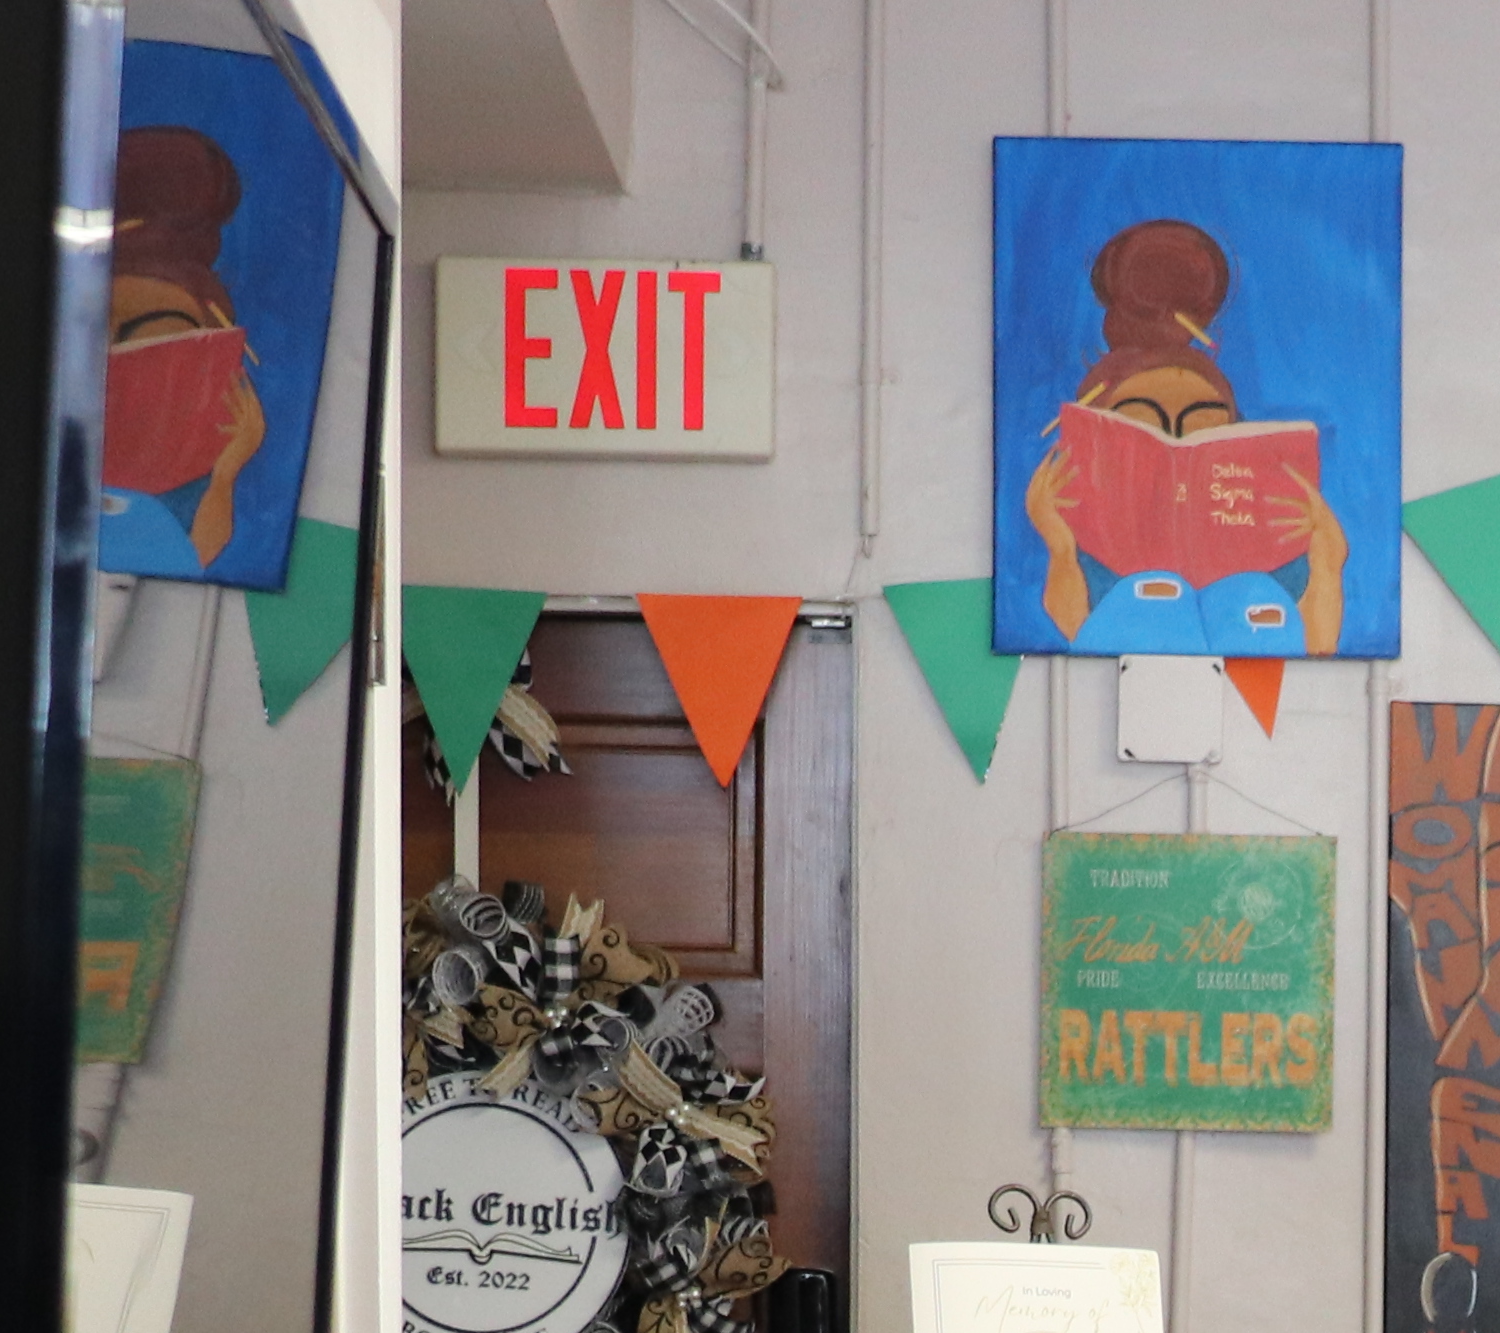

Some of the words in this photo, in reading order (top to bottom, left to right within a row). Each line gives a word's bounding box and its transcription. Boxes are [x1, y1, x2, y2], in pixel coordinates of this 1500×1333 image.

[504, 268, 721, 430] EXIT
[1209, 484, 1253, 508] Sigma
[1210, 511, 1256, 527] Theta
[1090, 869, 1170, 888] TRADITION
[1054, 915, 1161, 964] Florida
[1077, 969, 1120, 988] PRIDE
[1196, 972, 1290, 991] EXCELLENCE
[1057, 1008, 1319, 1089] RATTLERS
[402, 1080, 457, 1116] REE
[401, 1188, 454, 1222] ack
[426, 1265, 469, 1287] Est.
[478, 1270, 532, 1291] 2022
[1022, 1286, 1034, 1296] In
[1035, 1286, 1072, 1299] Loving
